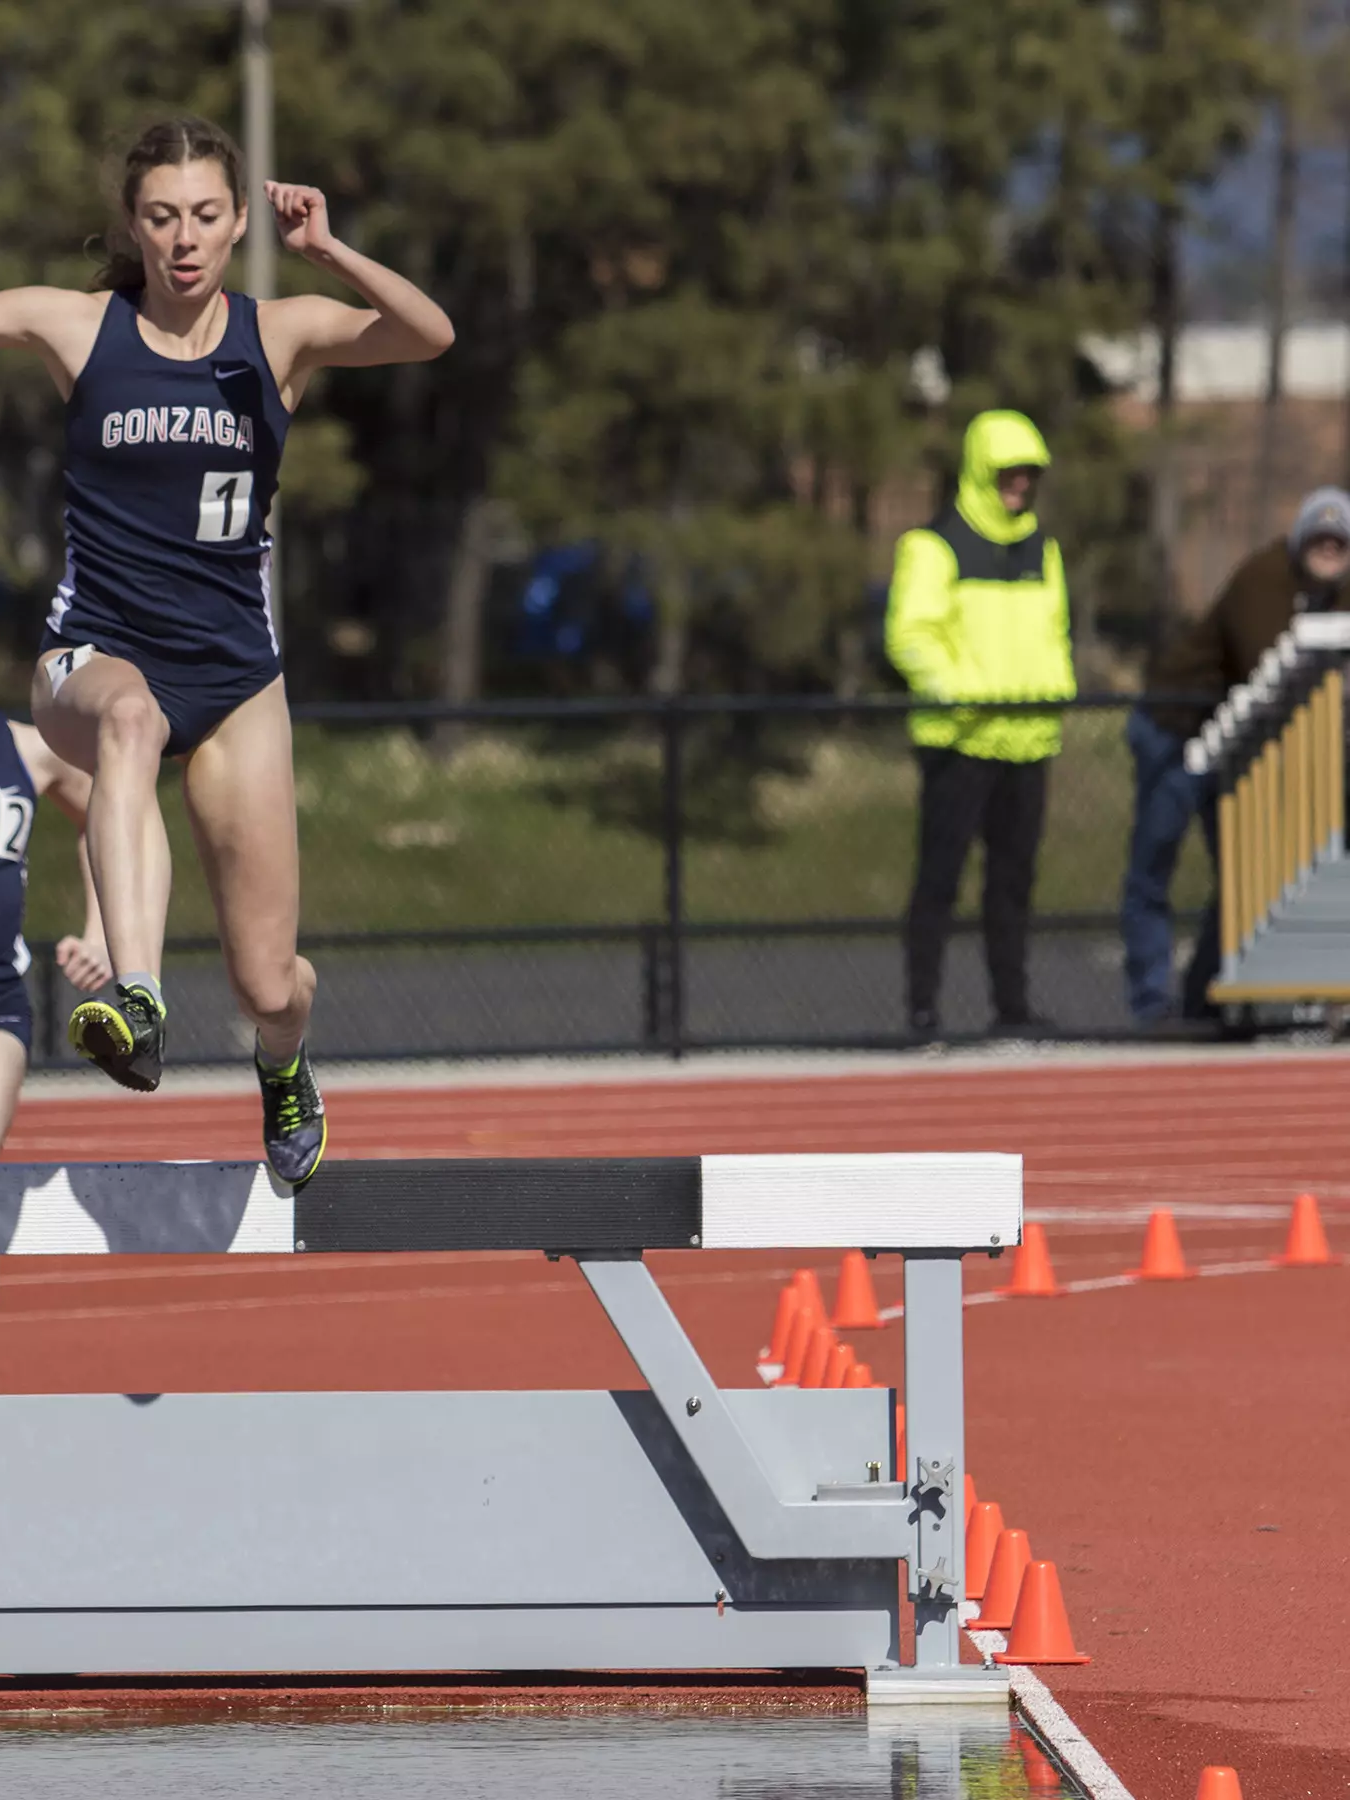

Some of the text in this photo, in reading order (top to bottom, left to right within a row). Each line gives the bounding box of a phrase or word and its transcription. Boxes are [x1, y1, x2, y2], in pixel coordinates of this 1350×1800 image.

[102, 406, 254, 453] GONZAGA
[215, 477, 238, 537] 1
[7, 802, 25, 854] 2
